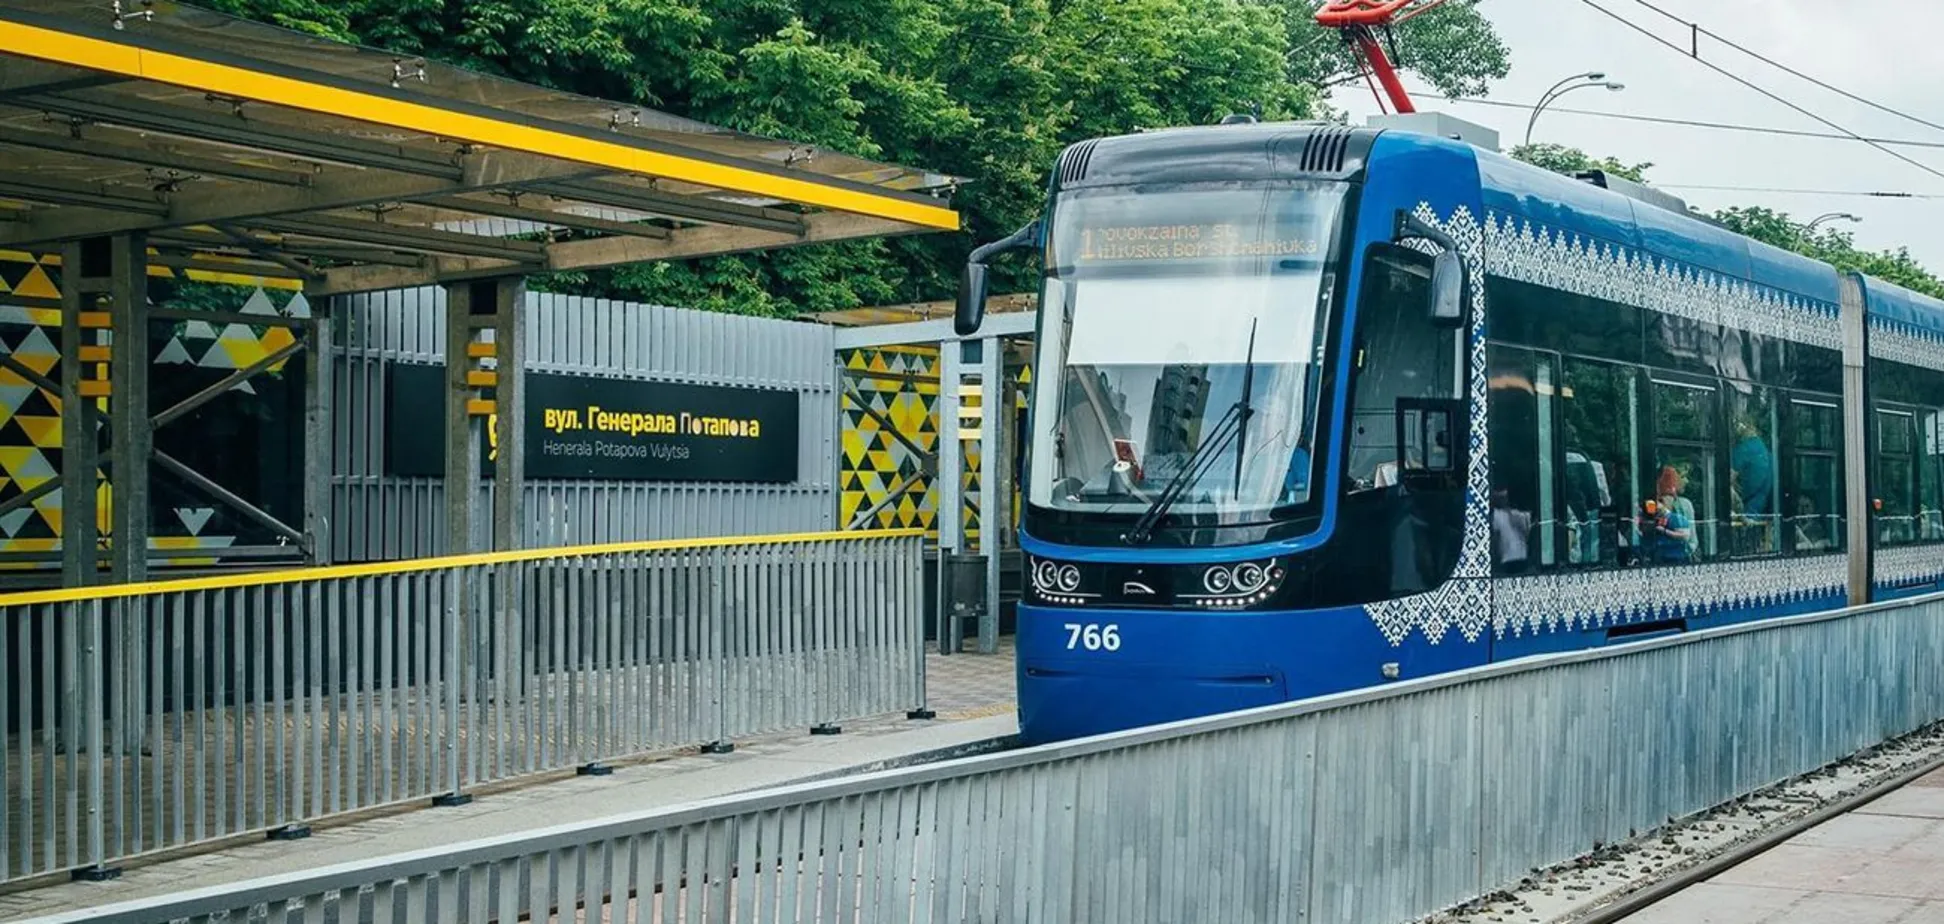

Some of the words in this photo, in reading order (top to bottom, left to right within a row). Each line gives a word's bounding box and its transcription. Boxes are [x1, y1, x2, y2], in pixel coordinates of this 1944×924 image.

[1080, 227, 1095, 259] 1
[544, 408, 583, 433] вул.
[587, 406, 676, 436] Генерала
[679, 411, 760, 437] Потапова
[543, 440, 593, 457] Henerala
[594, 440, 648, 459] Potapova
[650, 443, 691, 461] Vulytsia
[1063, 623, 1121, 651] 766
